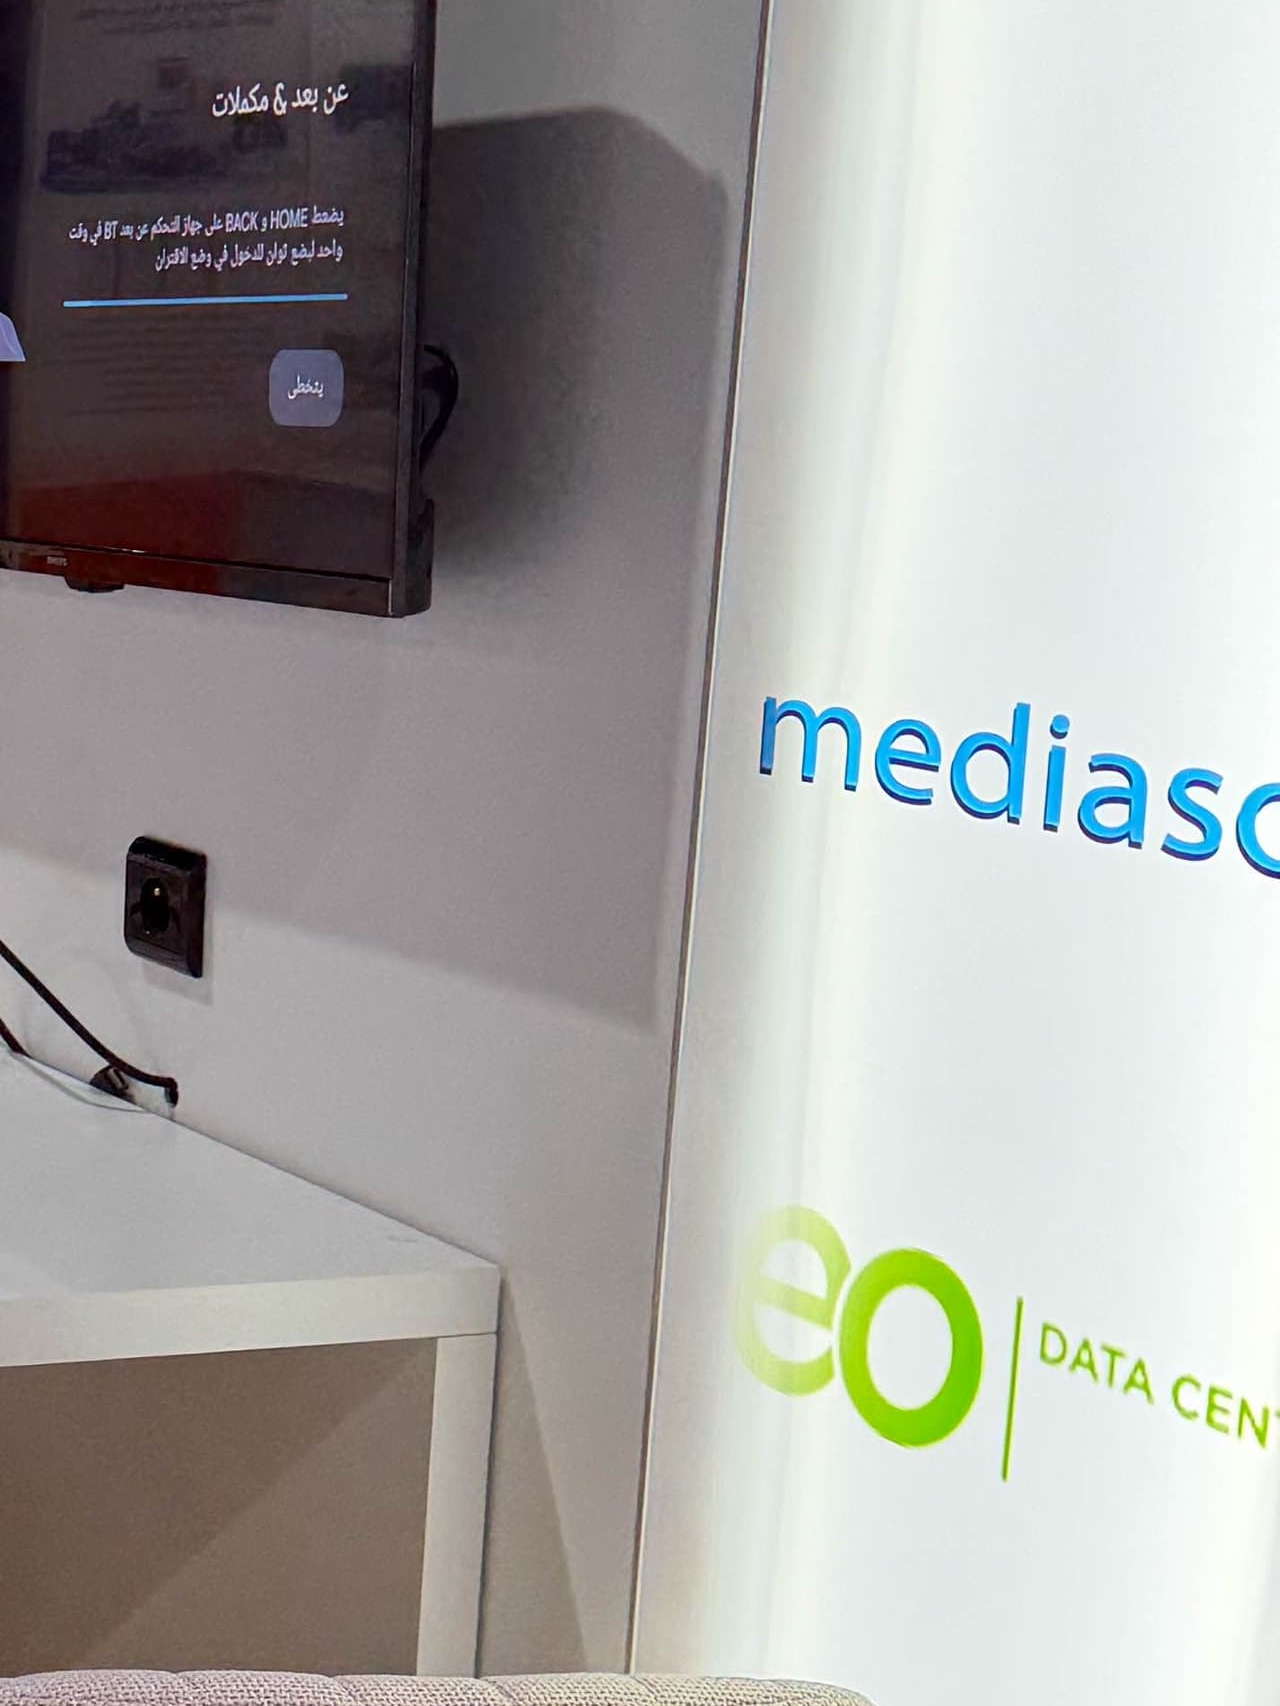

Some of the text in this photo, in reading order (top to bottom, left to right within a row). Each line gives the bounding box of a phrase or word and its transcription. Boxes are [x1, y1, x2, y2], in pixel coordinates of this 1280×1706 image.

[212, 81, 348, 117] عن بعد & مكملات
[104, 221, 119, 240] BT
[225, 211, 259, 232] BACK
[270, 207, 308, 230] HOME
[89, 221, 103, 246] في
[213, 243, 228, 272] في
[316, 238, 344, 262] واحد
[1039, 1322, 1155, 1405] DATA
[1171, 1374, 1280, 1449] CEN
